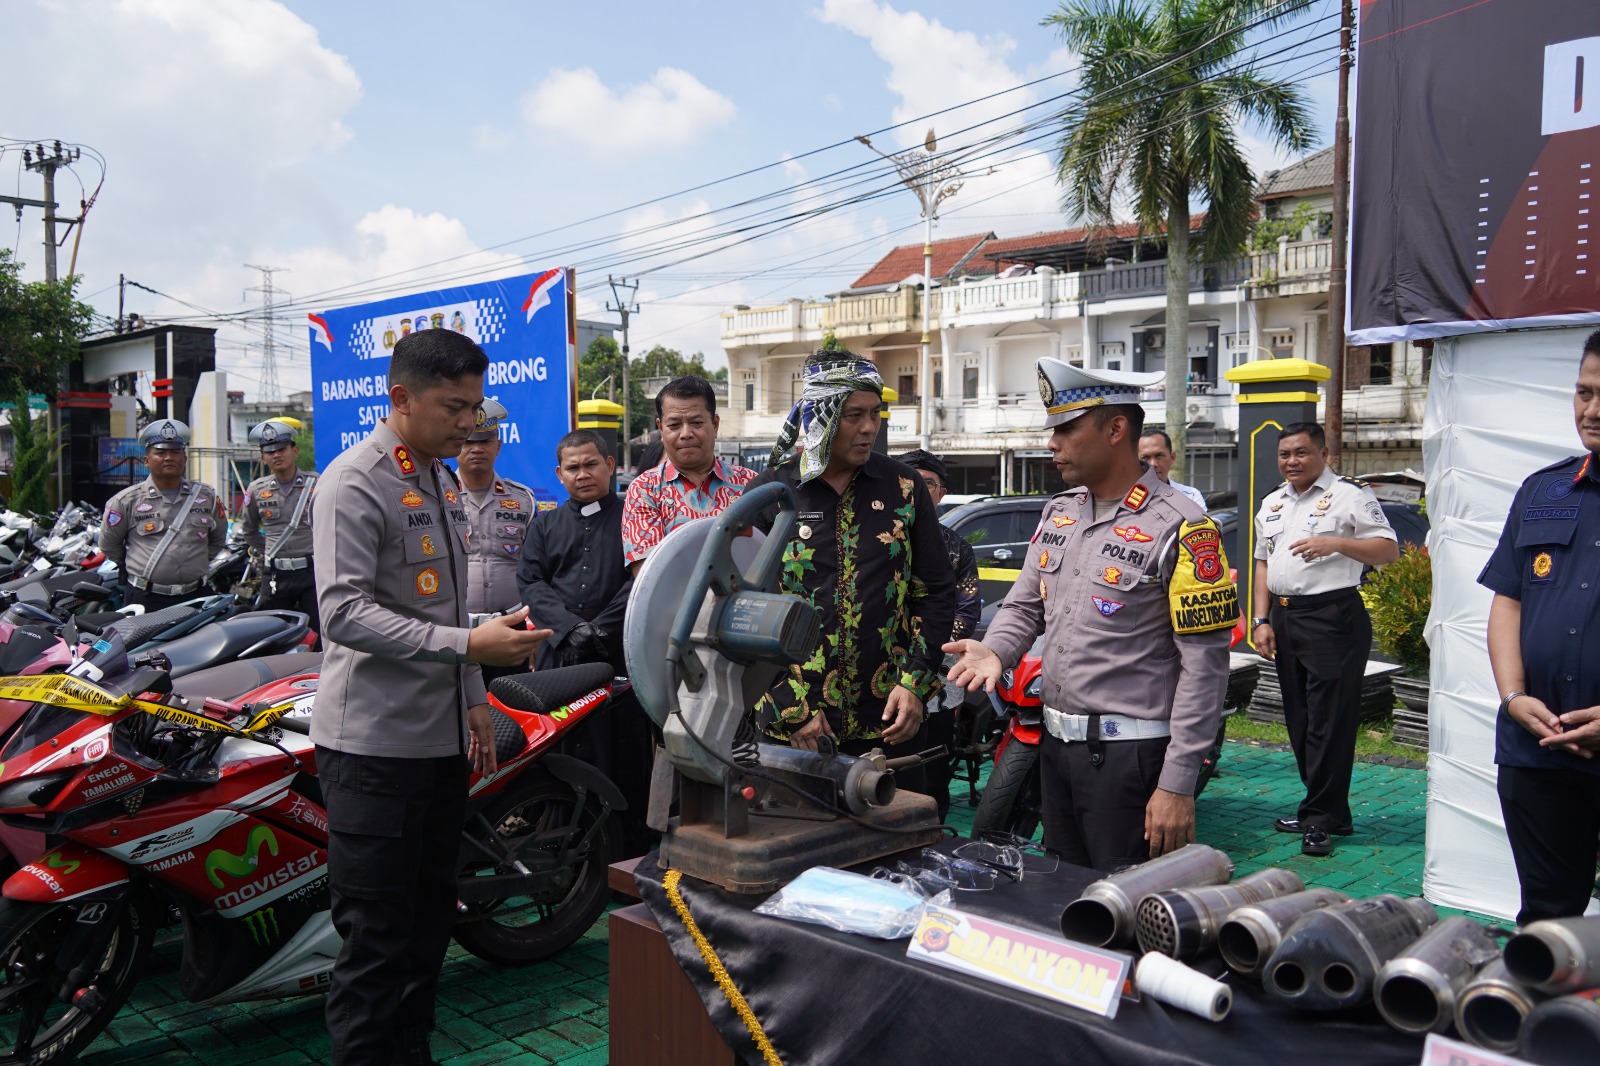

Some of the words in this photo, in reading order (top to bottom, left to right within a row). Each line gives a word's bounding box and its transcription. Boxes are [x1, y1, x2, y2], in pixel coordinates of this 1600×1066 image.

[322, 376, 373, 401] BARANG
[488, 358, 547, 386] BRONG
[498, 422, 521, 444] TA
[189, 507, 212, 515] POLRI
[407, 512, 433, 528] ANDI
[495, 511, 527, 521] POLRI
[1528, 509, 1572, 518] INDRA
[1042, 532, 1067, 547] RIKI
[1101, 543, 1145, 566] POLRI
[568, 687, 608, 712] movistar
[87, 742, 103, 757] FIAT
[87, 762, 128, 784] ENEOS
[81, 772, 137, 798] YAMALUBE
[143, 851, 196, 872] YAMAHA
[214, 850, 318, 909] movistar
[962, 927, 1109, 999] DANYON
